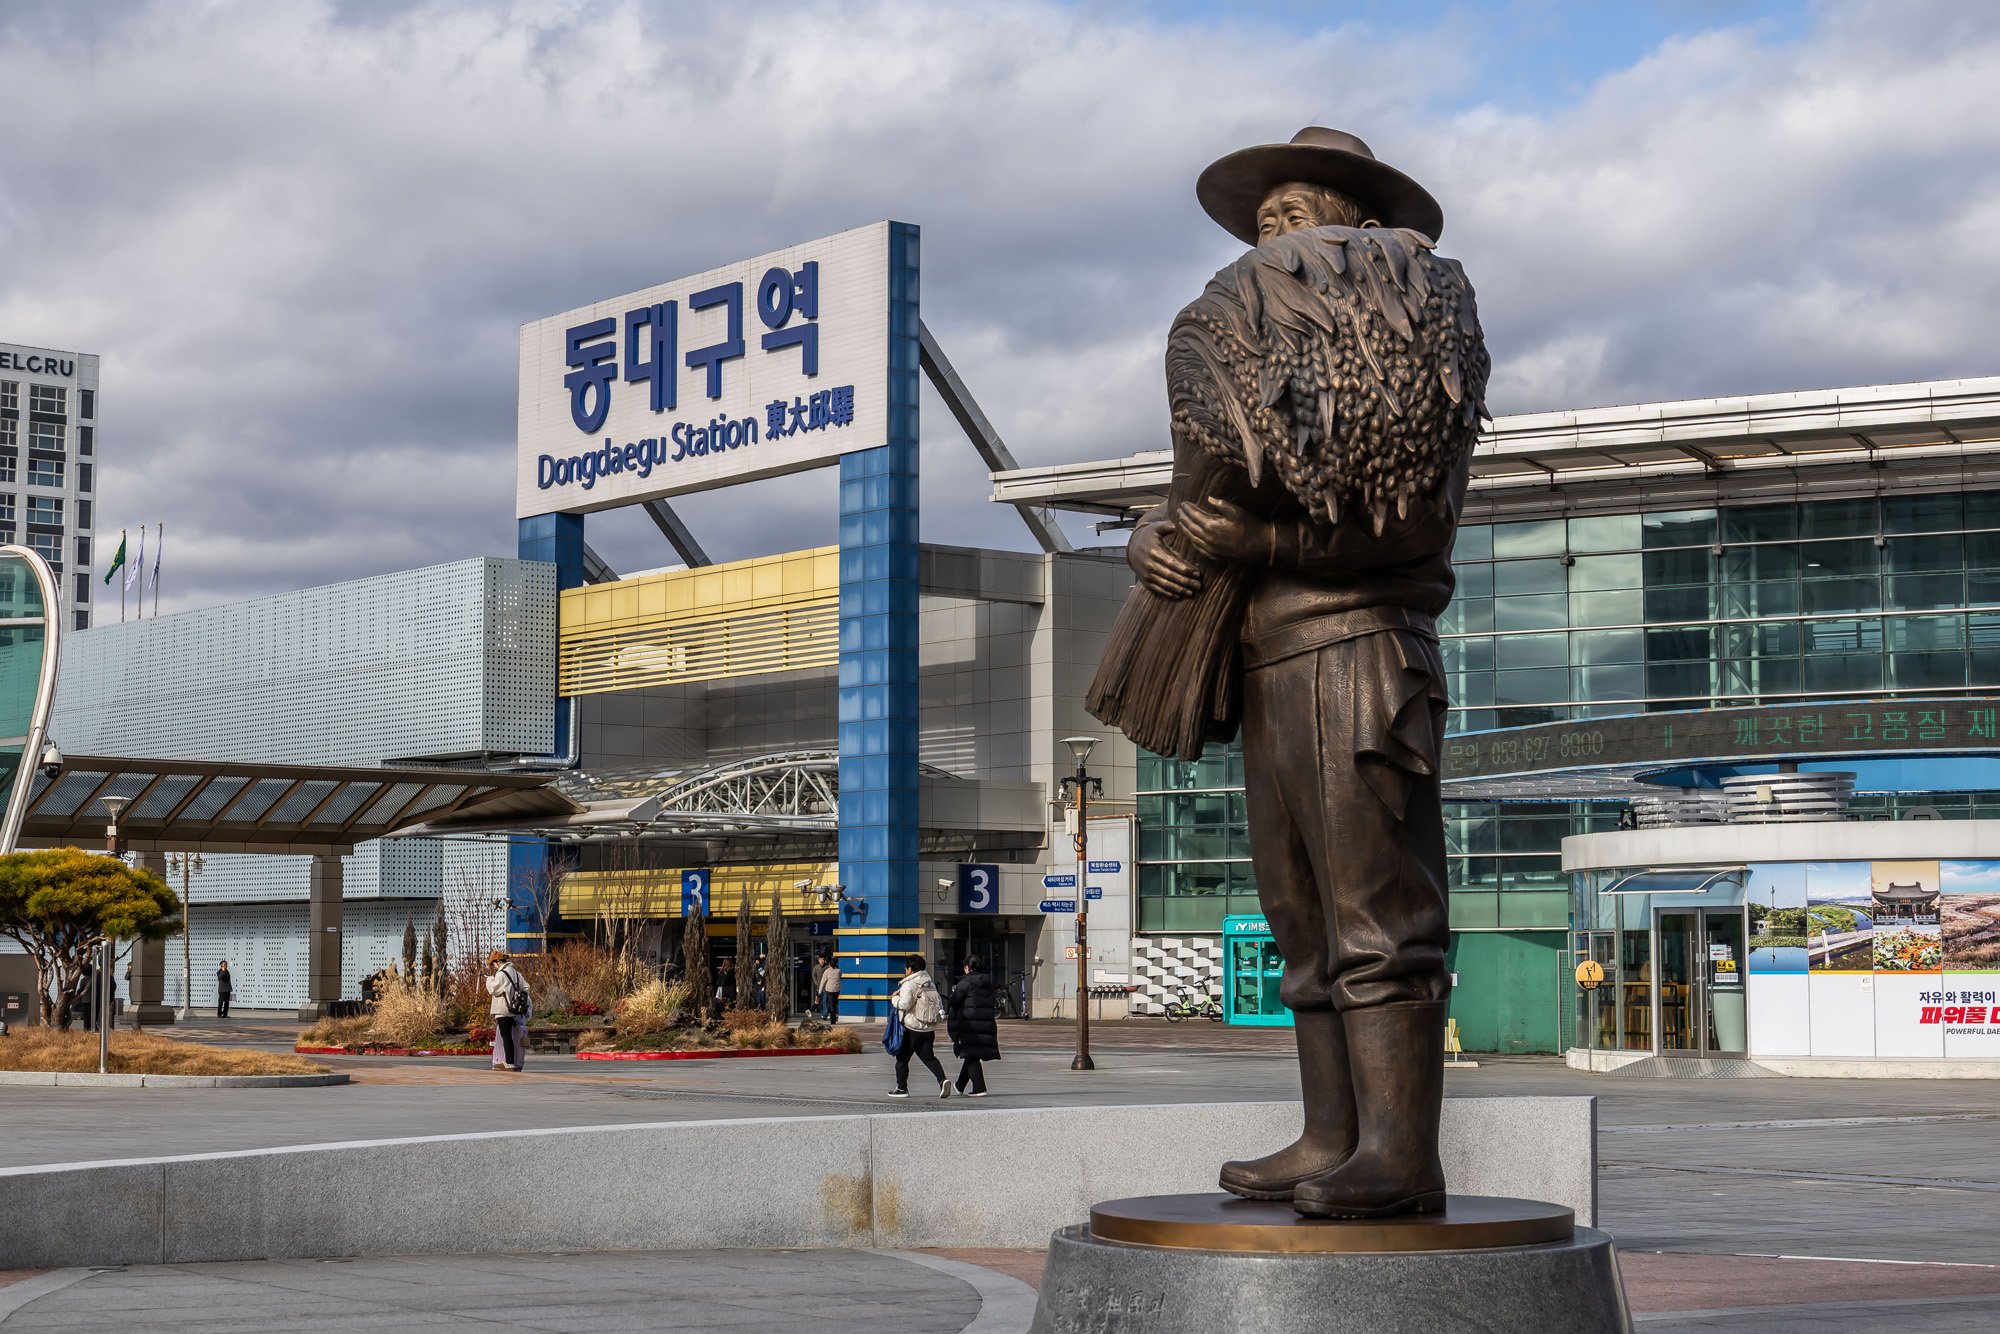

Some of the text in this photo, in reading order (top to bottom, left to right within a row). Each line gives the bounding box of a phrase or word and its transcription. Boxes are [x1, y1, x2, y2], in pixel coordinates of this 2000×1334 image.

[563, 261, 819, 433] 동대구역
[537, 435, 666, 490] Dongdaegu
[671, 413, 758, 462] Station
[1450, 742, 1479, 771] 문의
[1491, 731, 1604, 765] 053-627-8900
[1733, 713, 1827, 746] 깨끗한
[1843, 709, 1946, 740] 고품질
[688, 874, 702, 911] 3
[969, 869, 990, 909] 3
[813, 923, 819, 934] 3
[1919, 991, 1996, 1004] 자유와 활력이
[1919, 1006, 1987, 1024] 파워풀
